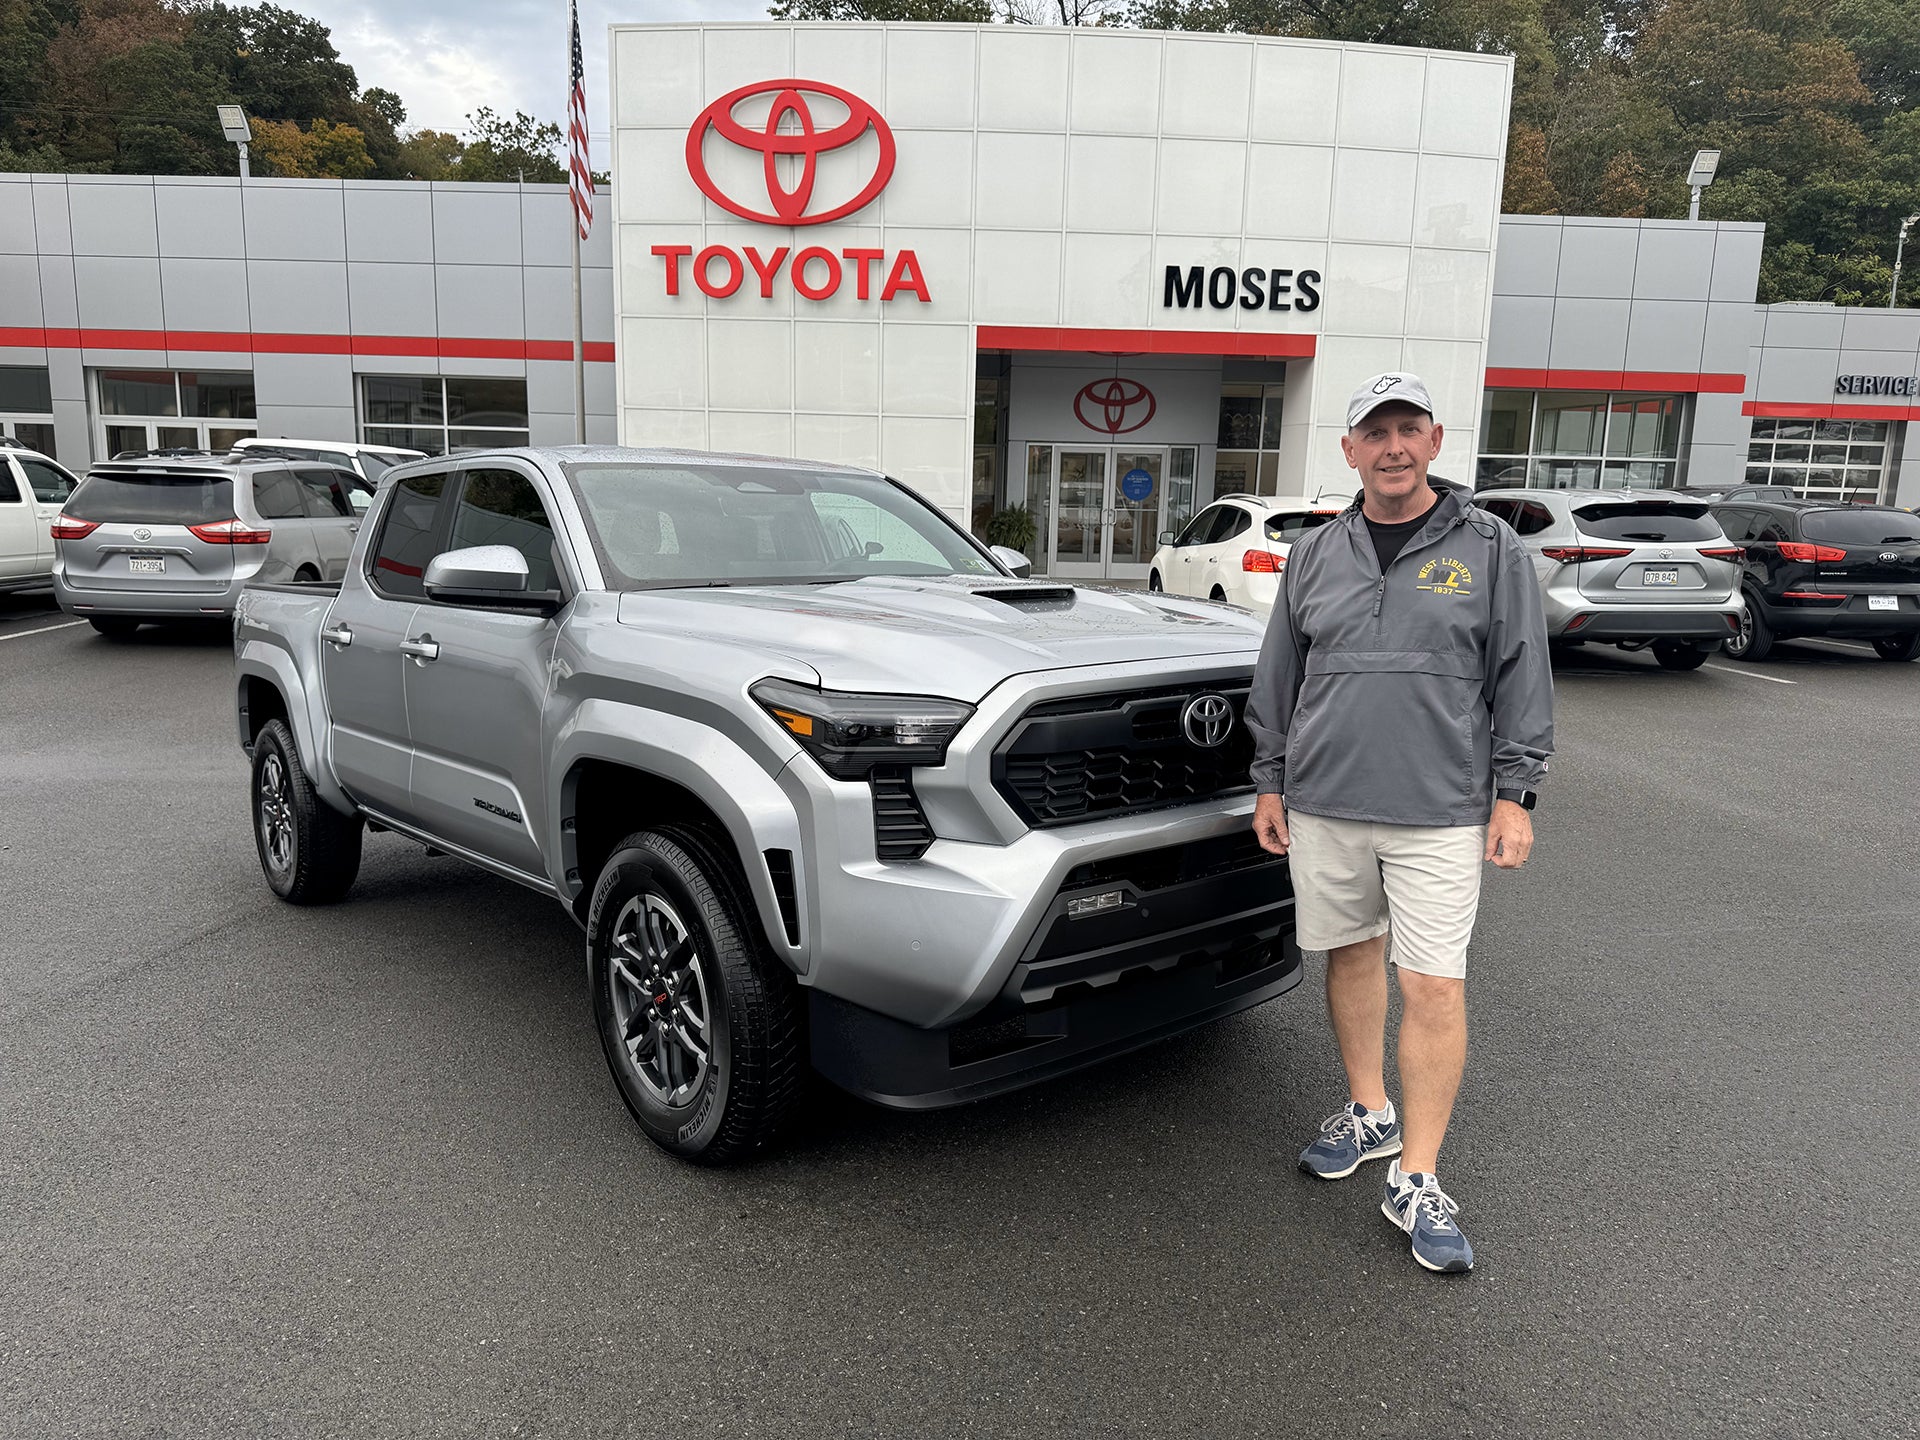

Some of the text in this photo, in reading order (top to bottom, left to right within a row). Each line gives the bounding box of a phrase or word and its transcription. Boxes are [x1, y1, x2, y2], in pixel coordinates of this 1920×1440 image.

[651, 245, 932, 303] TOYOTA
[1164, 265, 1321, 312] MOSES
[1836, 375, 1918, 396] SERVICE
[1418, 557, 1472, 583] WEST LIBERTY
[1662, 572, 1676, 582] 842
